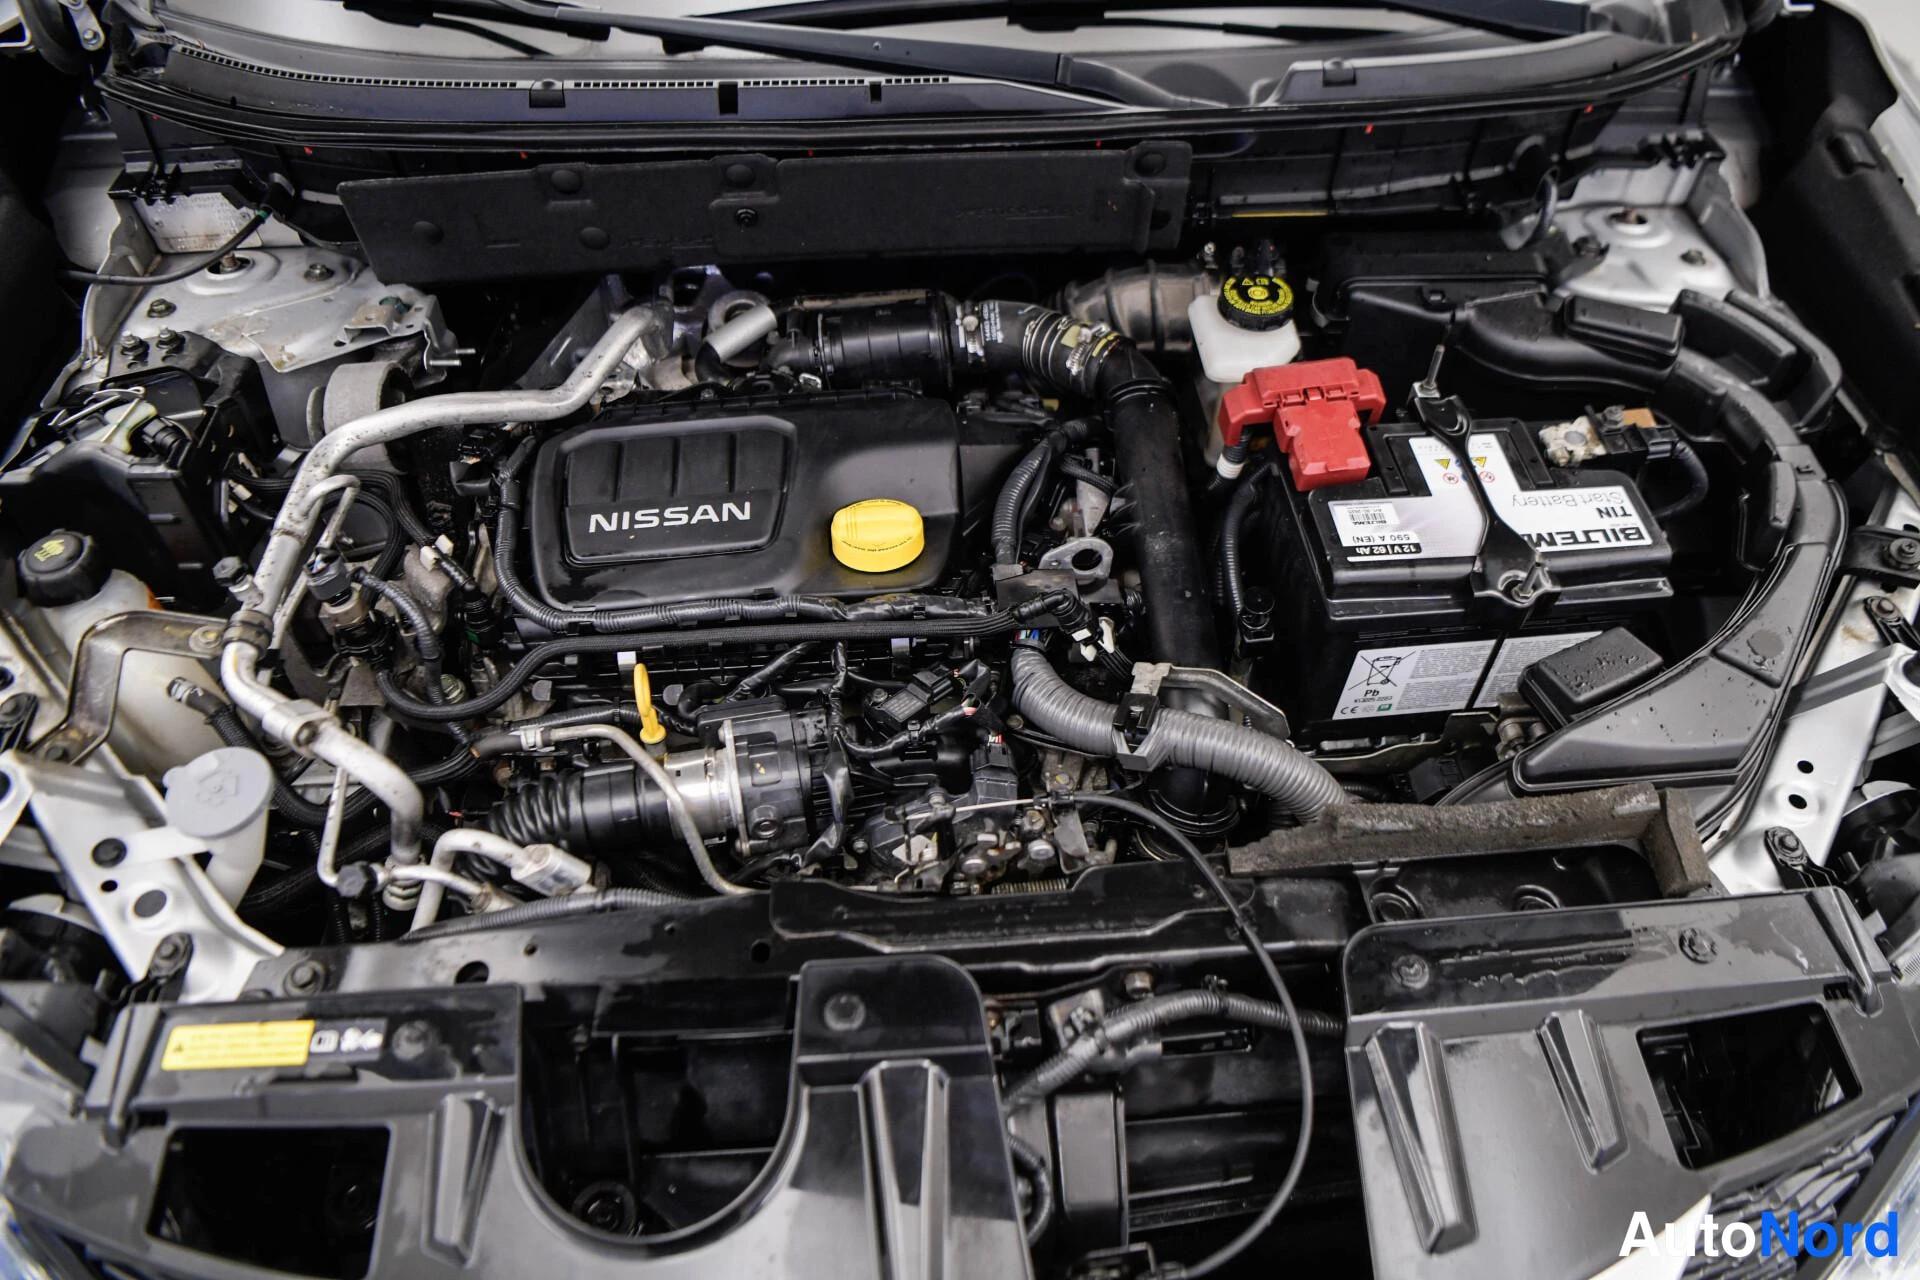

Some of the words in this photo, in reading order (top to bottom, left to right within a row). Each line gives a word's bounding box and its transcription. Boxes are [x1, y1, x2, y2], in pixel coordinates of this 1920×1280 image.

[1512, 494, 1578, 509] Battery
[1579, 490, 1624, 505] Start
[588, 501, 751, 533] NISSAN
[1596, 505, 1632, 519] TIN
[1352, 535, 1375, 544] (EN)
[1389, 534, 1411, 542] 590
[1518, 526, 1645, 548] BILTEM
[1355, 546, 1371, 555] Ah
[1363, 688, 1380, 698] Pb
